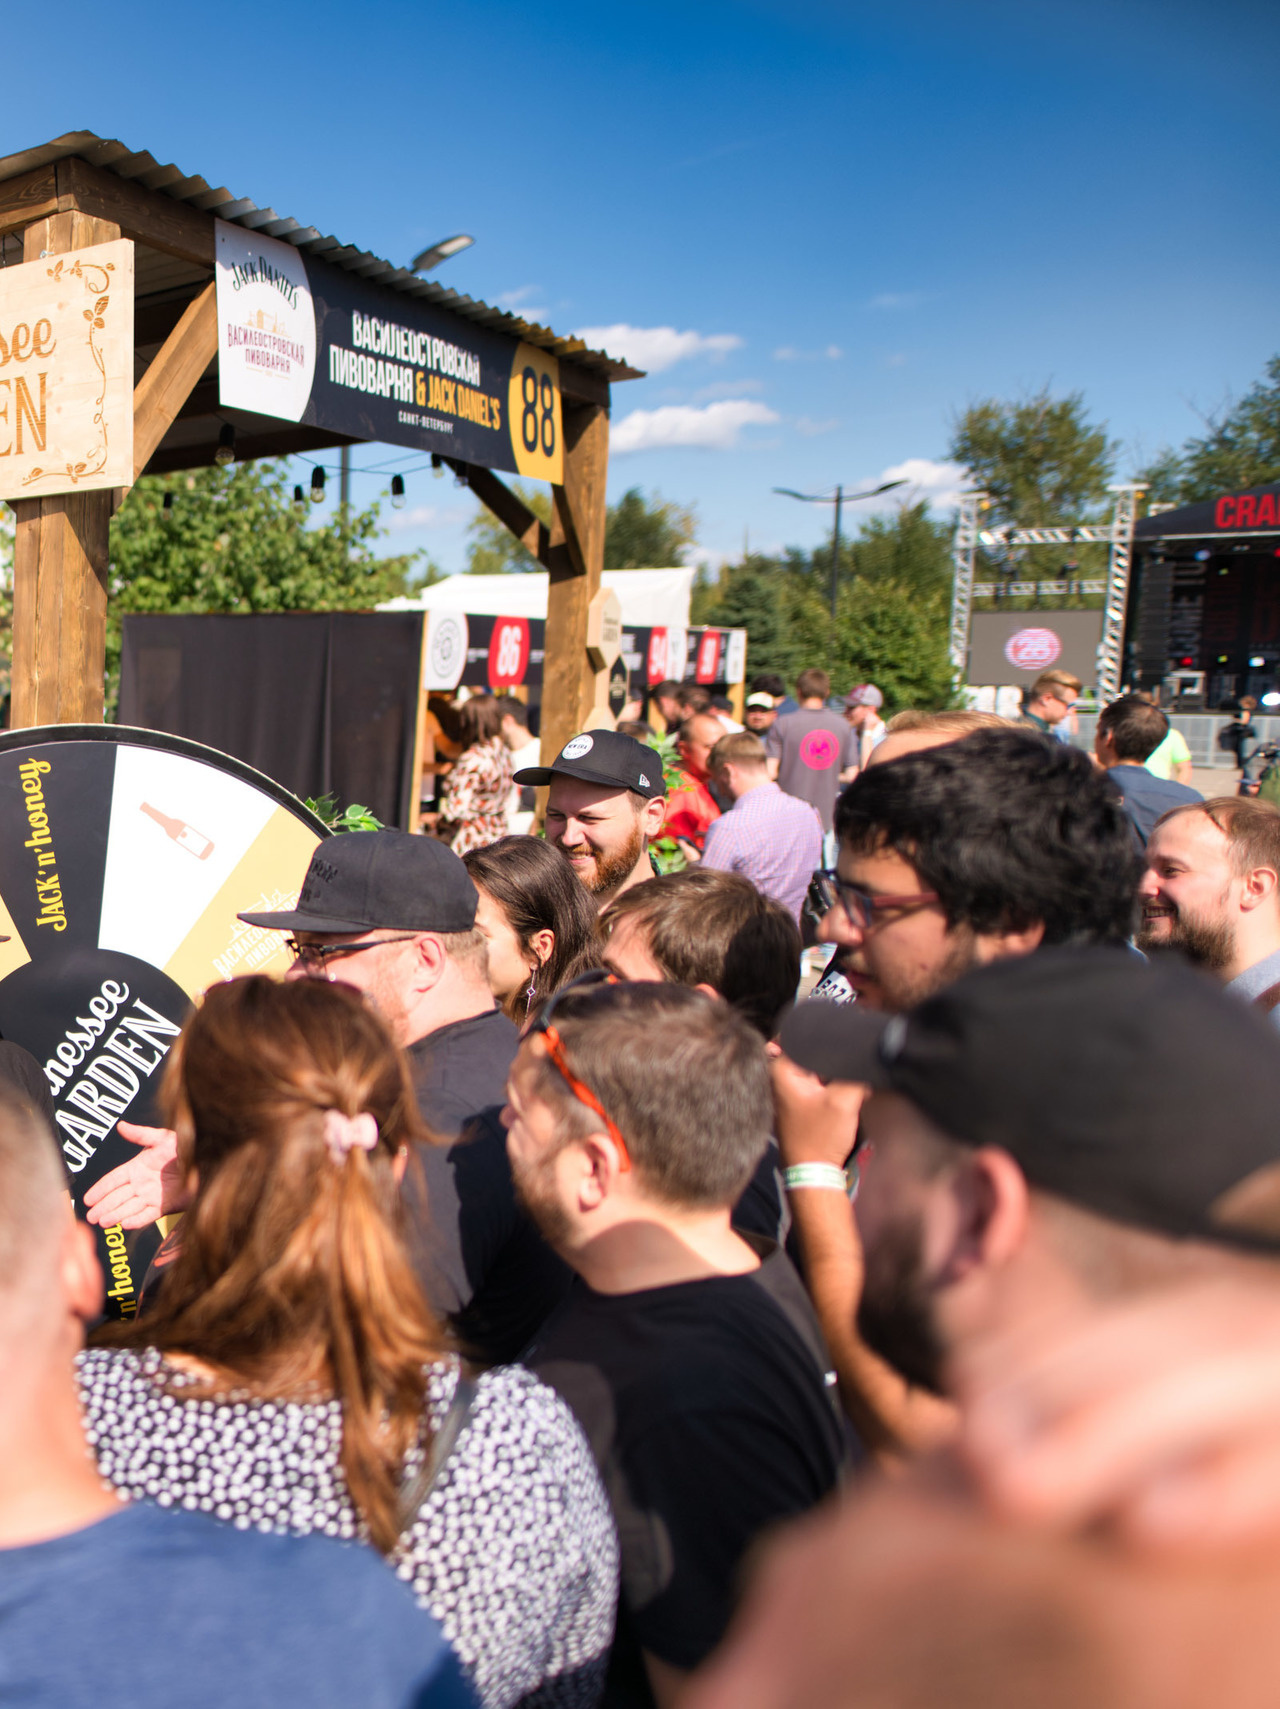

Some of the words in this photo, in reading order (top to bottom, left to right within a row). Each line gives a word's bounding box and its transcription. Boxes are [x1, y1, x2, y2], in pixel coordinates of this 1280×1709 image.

[231, 260, 259, 291] JACK
[259, 255, 299, 310] DANIEL'S
[227, 323, 305, 368] ВАСИЛЕОСТРОВСКАЯ
[245, 348, 291, 373] ПИВОВАРНЯ
[352, 309, 481, 387] ВАСИЛЕОСТРОВСКАЯ
[329, 344, 414, 404] ПИВОВАРНЯ
[415, 371, 426, 407] &
[427, 374, 457, 416] JACK
[457, 384, 501, 431] DANIEL'S
[522, 366, 556, 458] 88
[398, 410, 454, 434] САНКТ-ПЕТЕРБУРГ
[1216, 494, 1280, 529] CRA
[497, 625, 522, 677] 86
[244, 929, 294, 968] ПИВОВА
[43, 979, 130, 1096] nessee
